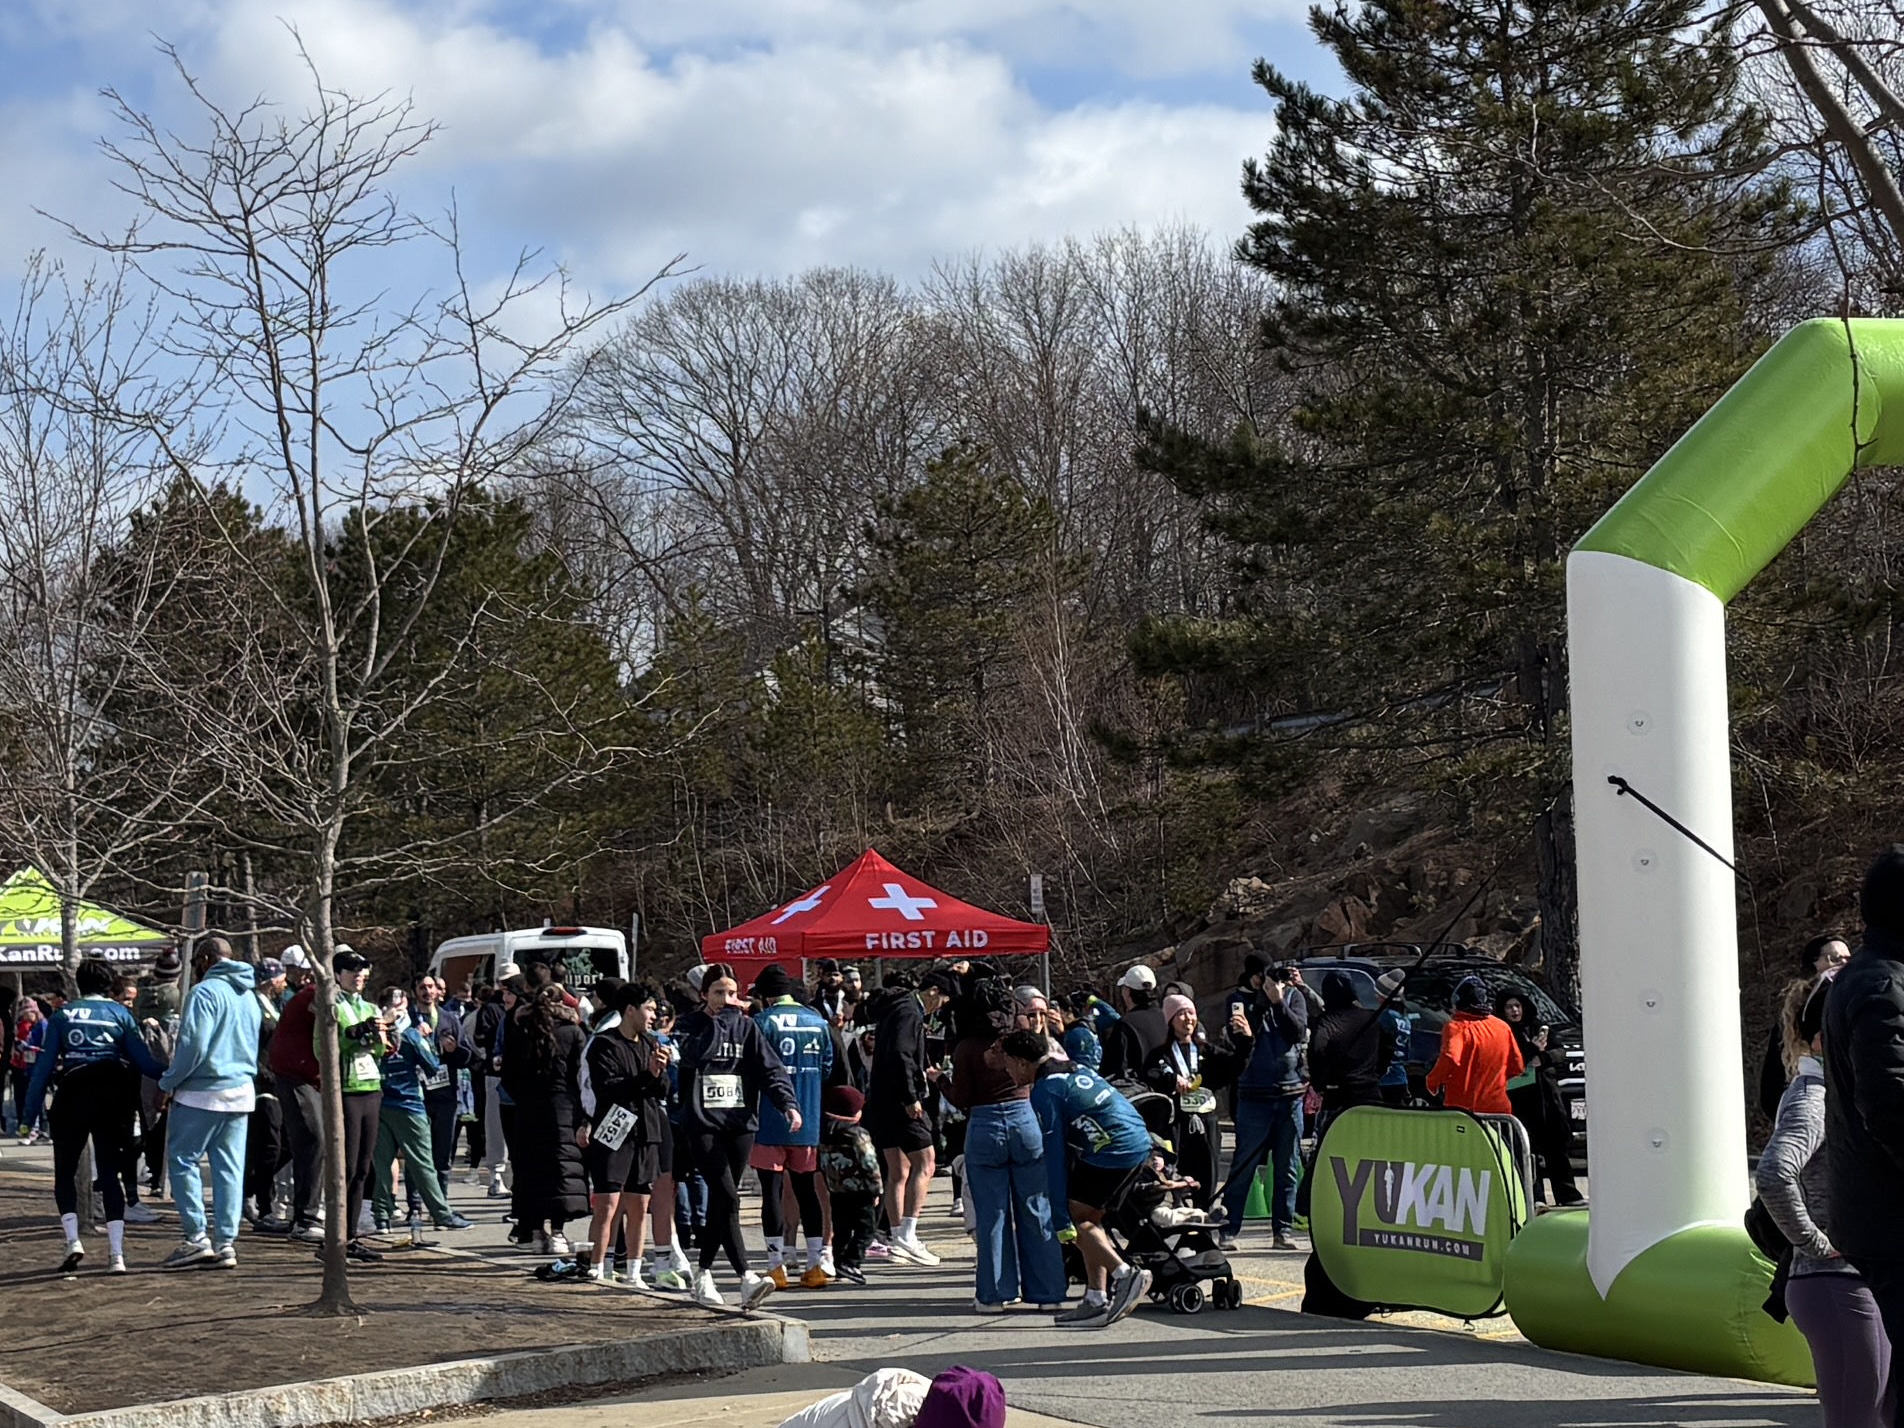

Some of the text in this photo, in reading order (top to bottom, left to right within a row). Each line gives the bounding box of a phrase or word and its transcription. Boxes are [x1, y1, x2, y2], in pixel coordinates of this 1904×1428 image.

[725, 937, 777, 954] FIRST AID
[866, 930, 988, 950] FIRST AID
[1329, 1156, 1491, 1246] YUKAN
[1374, 1234, 1470, 1256] YUKANRUN.COM
